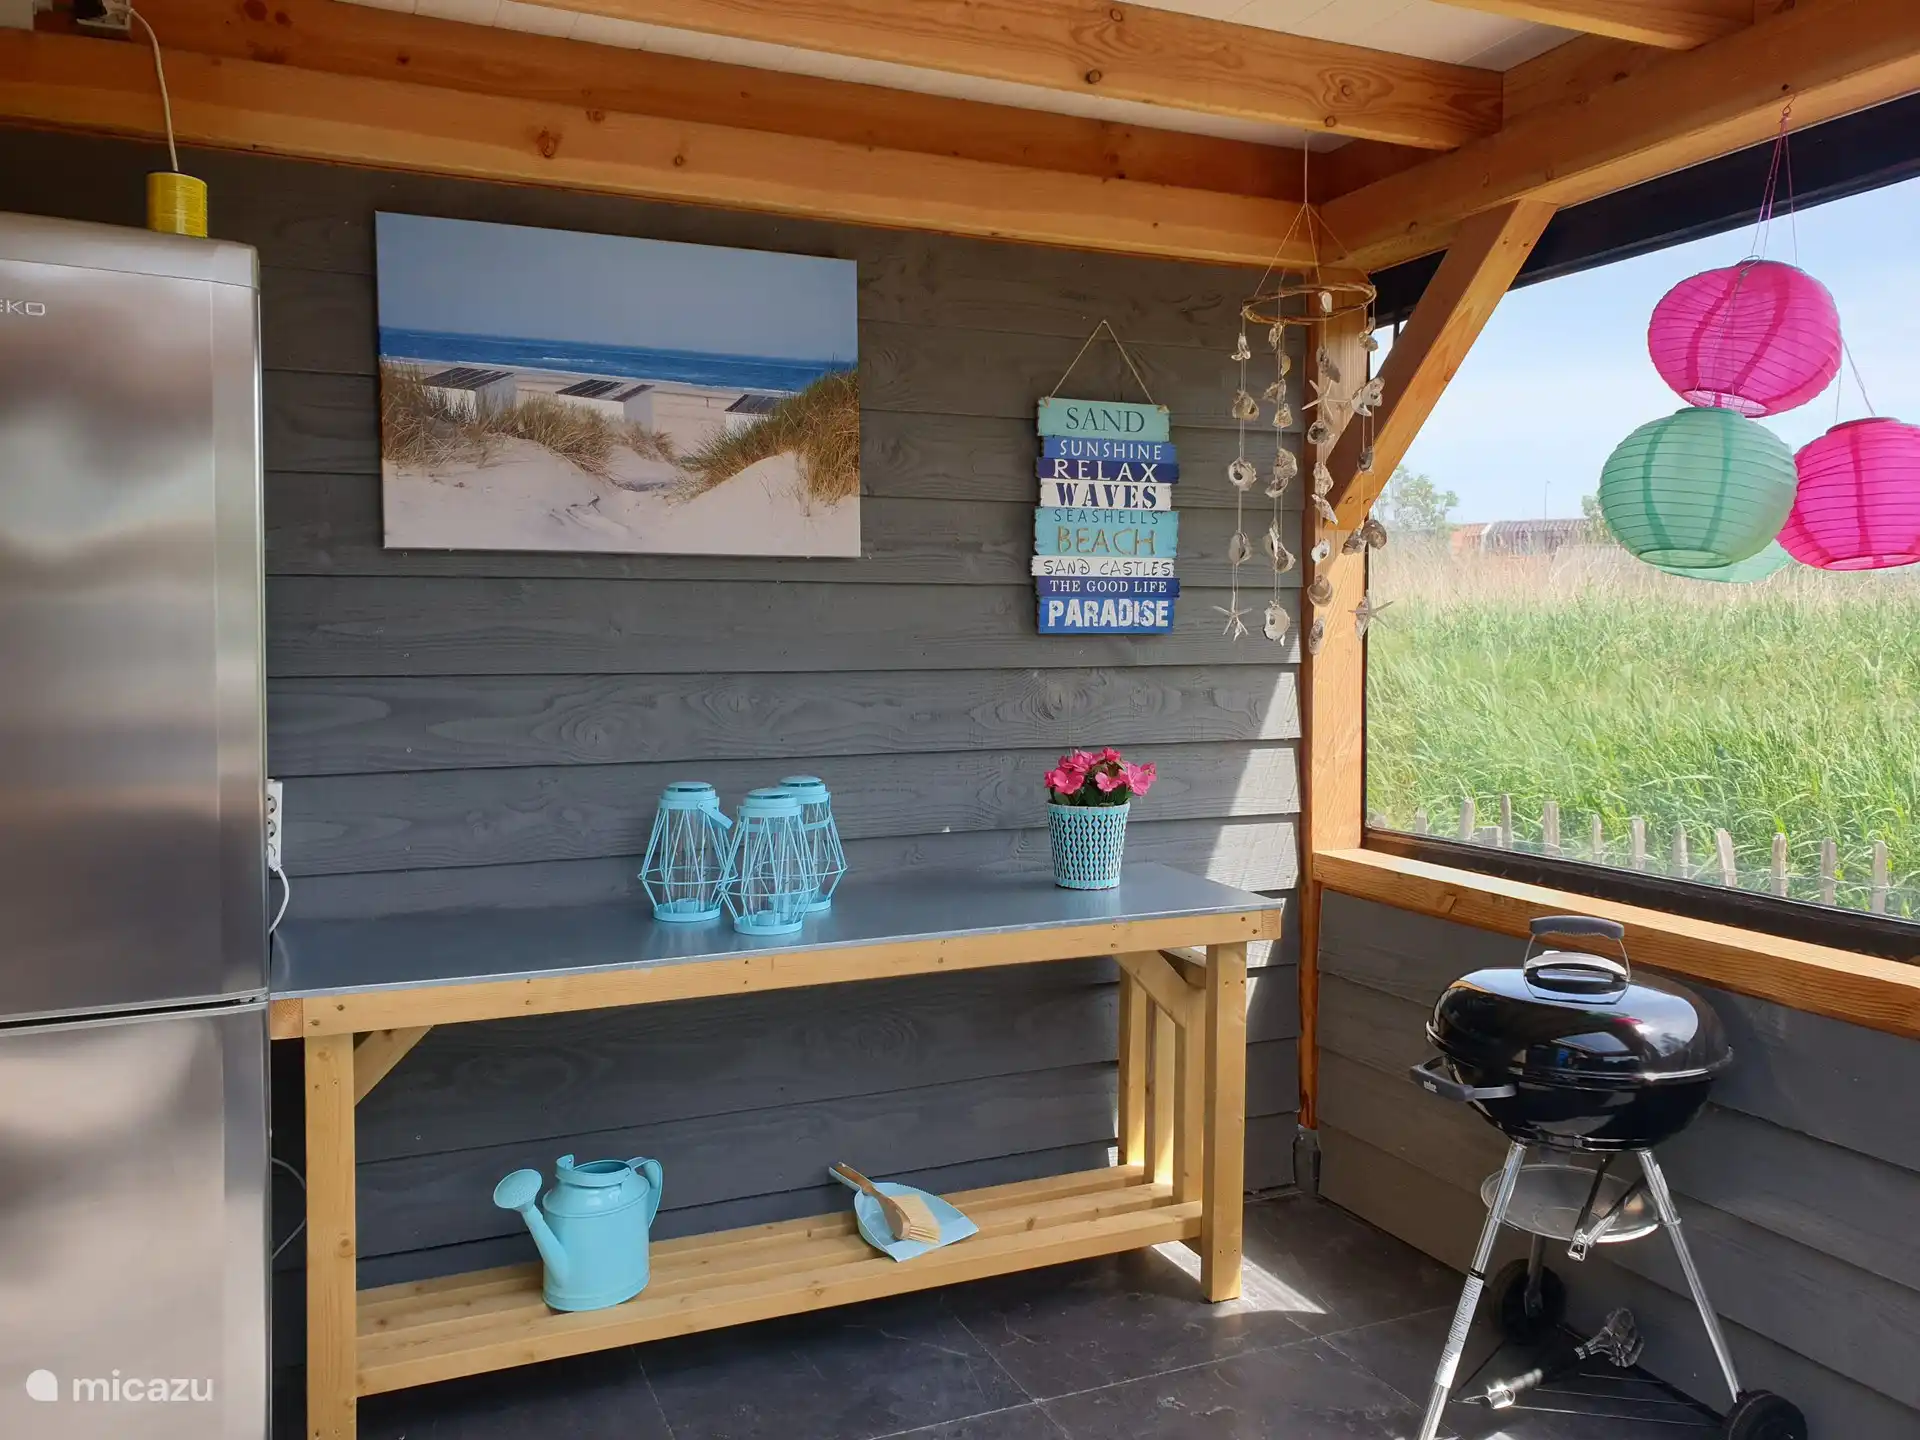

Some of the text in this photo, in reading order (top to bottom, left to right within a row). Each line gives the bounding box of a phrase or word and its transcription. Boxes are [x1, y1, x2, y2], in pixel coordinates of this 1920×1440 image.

[0, 299, 46, 316] KO
[1066, 407, 1145, 433] SAND
[1060, 440, 1162, 460] SUNSHINE
[1053, 458, 1158, 483] RELAX
[1056, 482, 1157, 509] WAVES
[1054, 508, 1159, 525] SEASHELLS
[1057, 526, 1156, 556] BEACH
[1043, 558, 1172, 576] SAND CASTLES
[1050, 580, 1167, 593] THE GOOD LIFE
[1048, 599, 1169, 628] PARADISE
